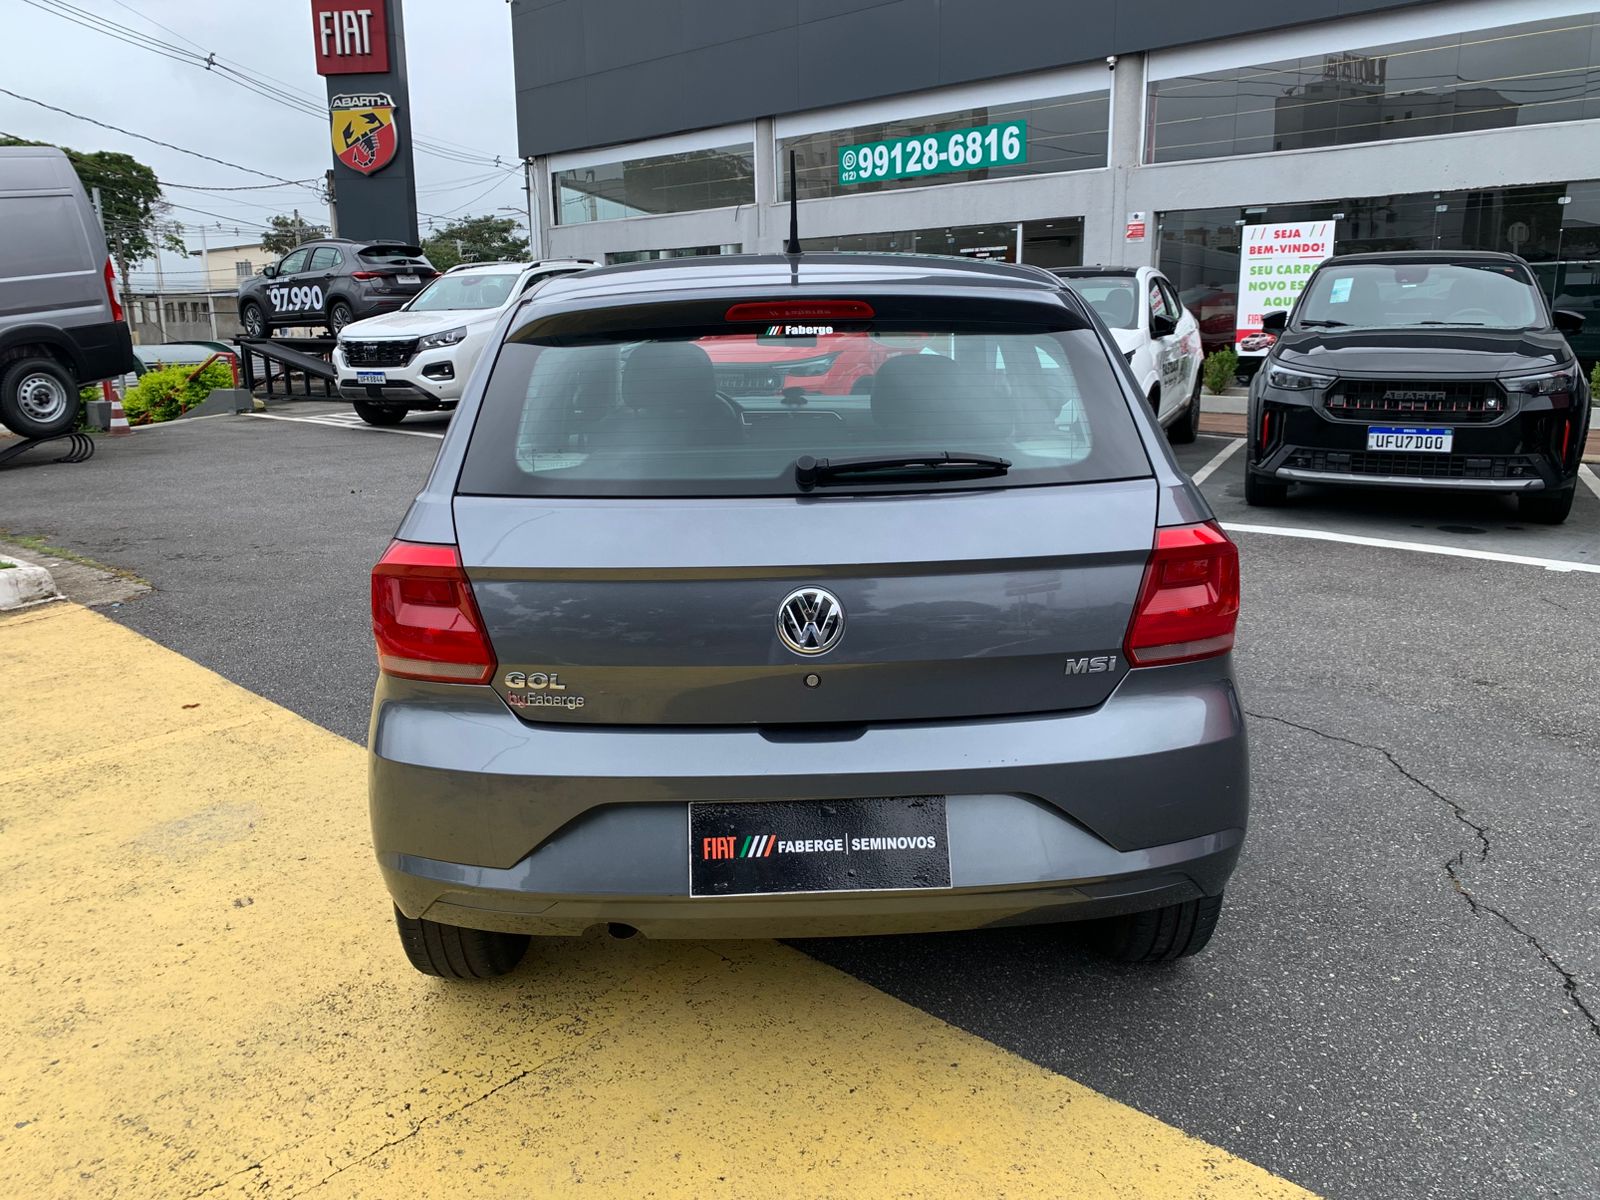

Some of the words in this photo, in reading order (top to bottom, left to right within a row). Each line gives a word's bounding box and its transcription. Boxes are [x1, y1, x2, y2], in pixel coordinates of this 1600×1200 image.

[319, 9, 373, 56] FIAT
[332, 96, 388, 108] ABARTH
[842, 170, 857, 181] (12)
[858, 125, 1020, 179] 99128-6816
[1273, 229, 1302, 239] SEJA
[1248, 243, 1325, 255] BEM-VINDO!
[1249, 265, 1273, 276] SEU
[1248, 280, 1286, 292] NOVO
[270, 285, 323, 312] 97.990
[785, 325, 834, 336] Faberge
[1382, 390, 1447, 400] ABARTH
[504, 671, 566, 690] GOL
[702, 835, 737, 860] FIAT
[777, 838, 844, 854] FABERGE
[851, 835, 937, 851] SEMINOVOS
